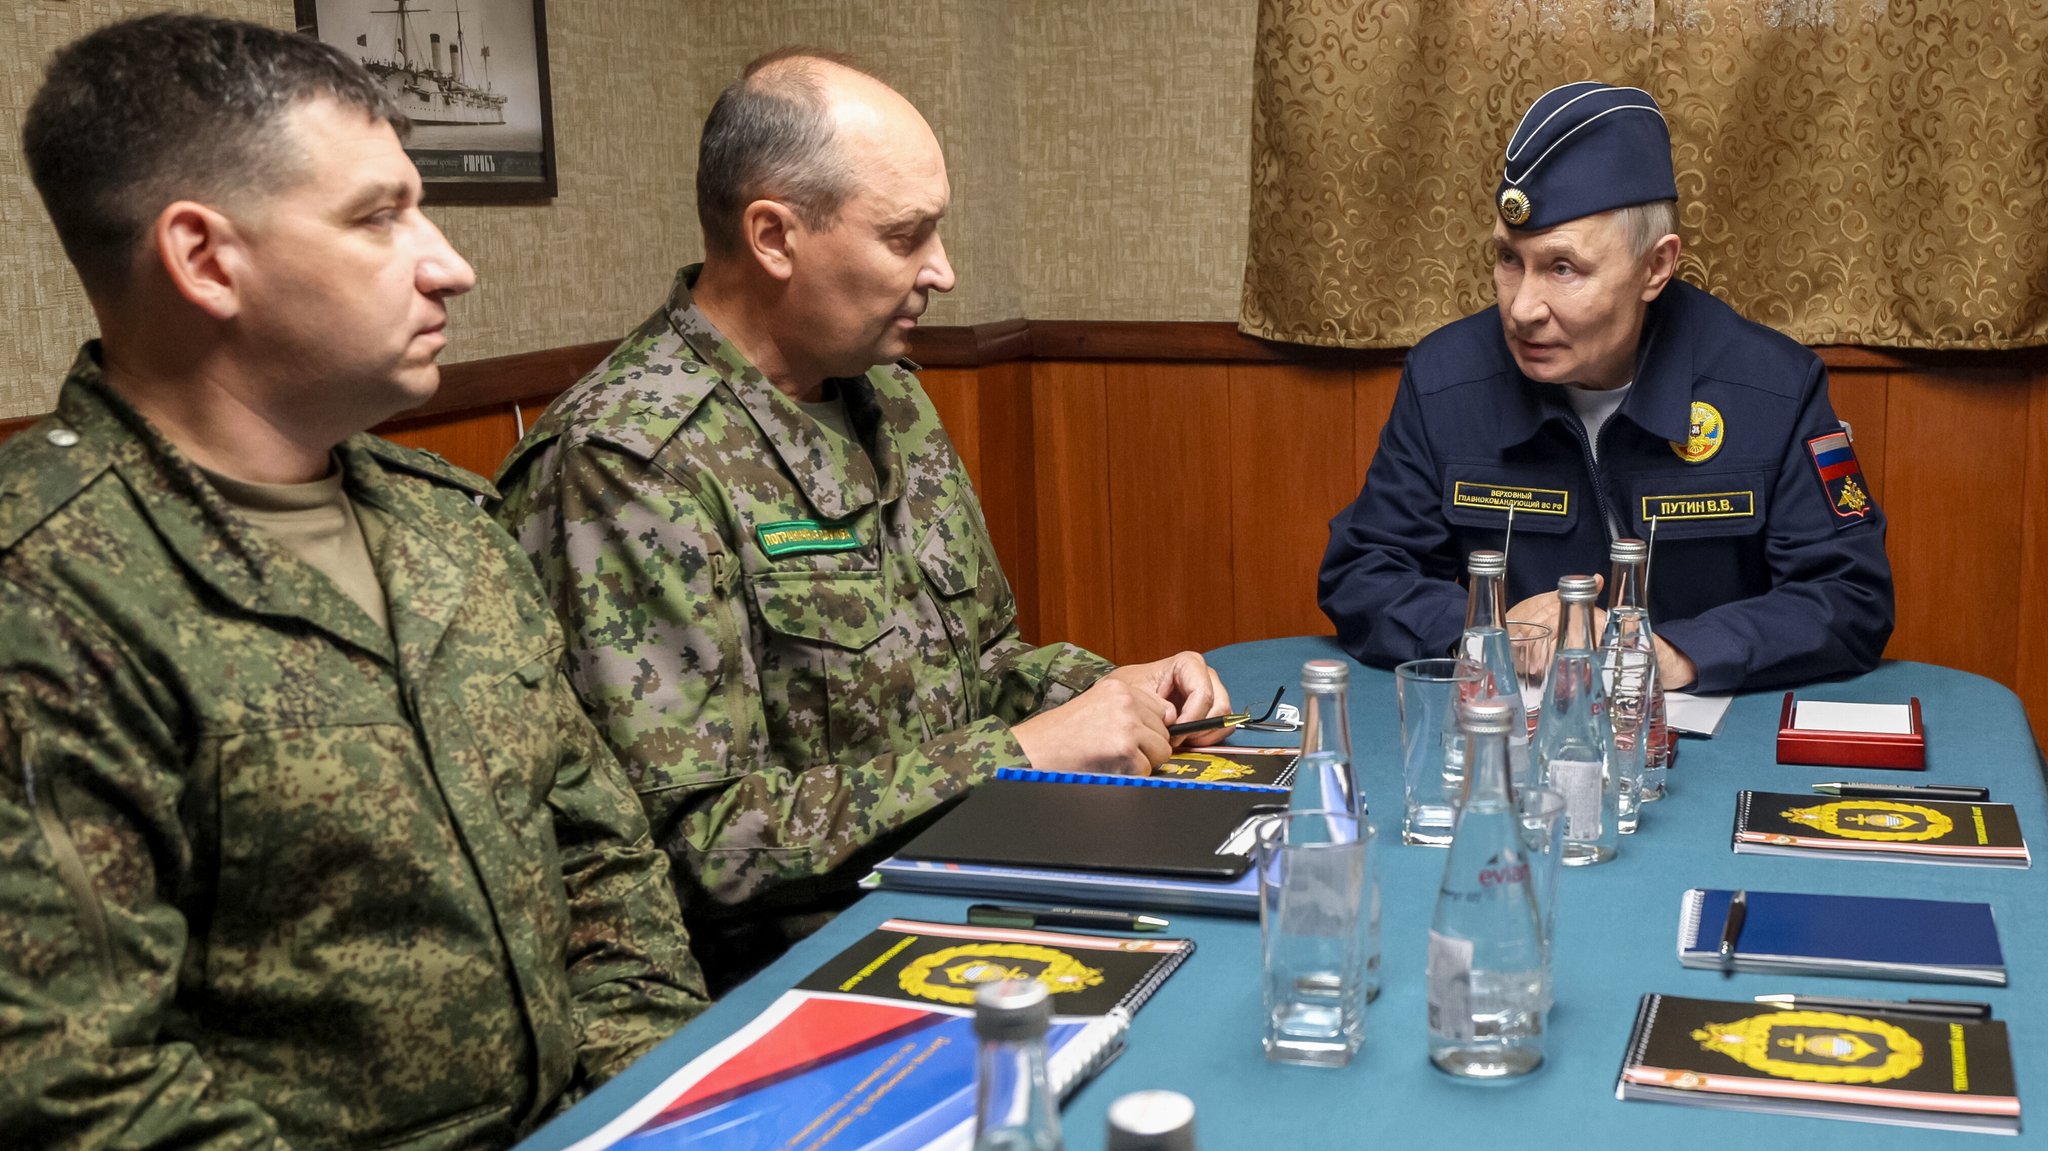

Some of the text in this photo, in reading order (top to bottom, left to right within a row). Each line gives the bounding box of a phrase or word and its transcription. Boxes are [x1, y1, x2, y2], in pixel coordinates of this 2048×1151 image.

[1458, 494, 1540, 509] ГЛАВНОКОМАНДУЮЩИЙ
[1552, 502, 1563, 510] РФ
[1491, 489, 1532, 500] ВЕРХОВНЫЙ
[1661, 499, 1734, 514] ПУТИН В.В.
